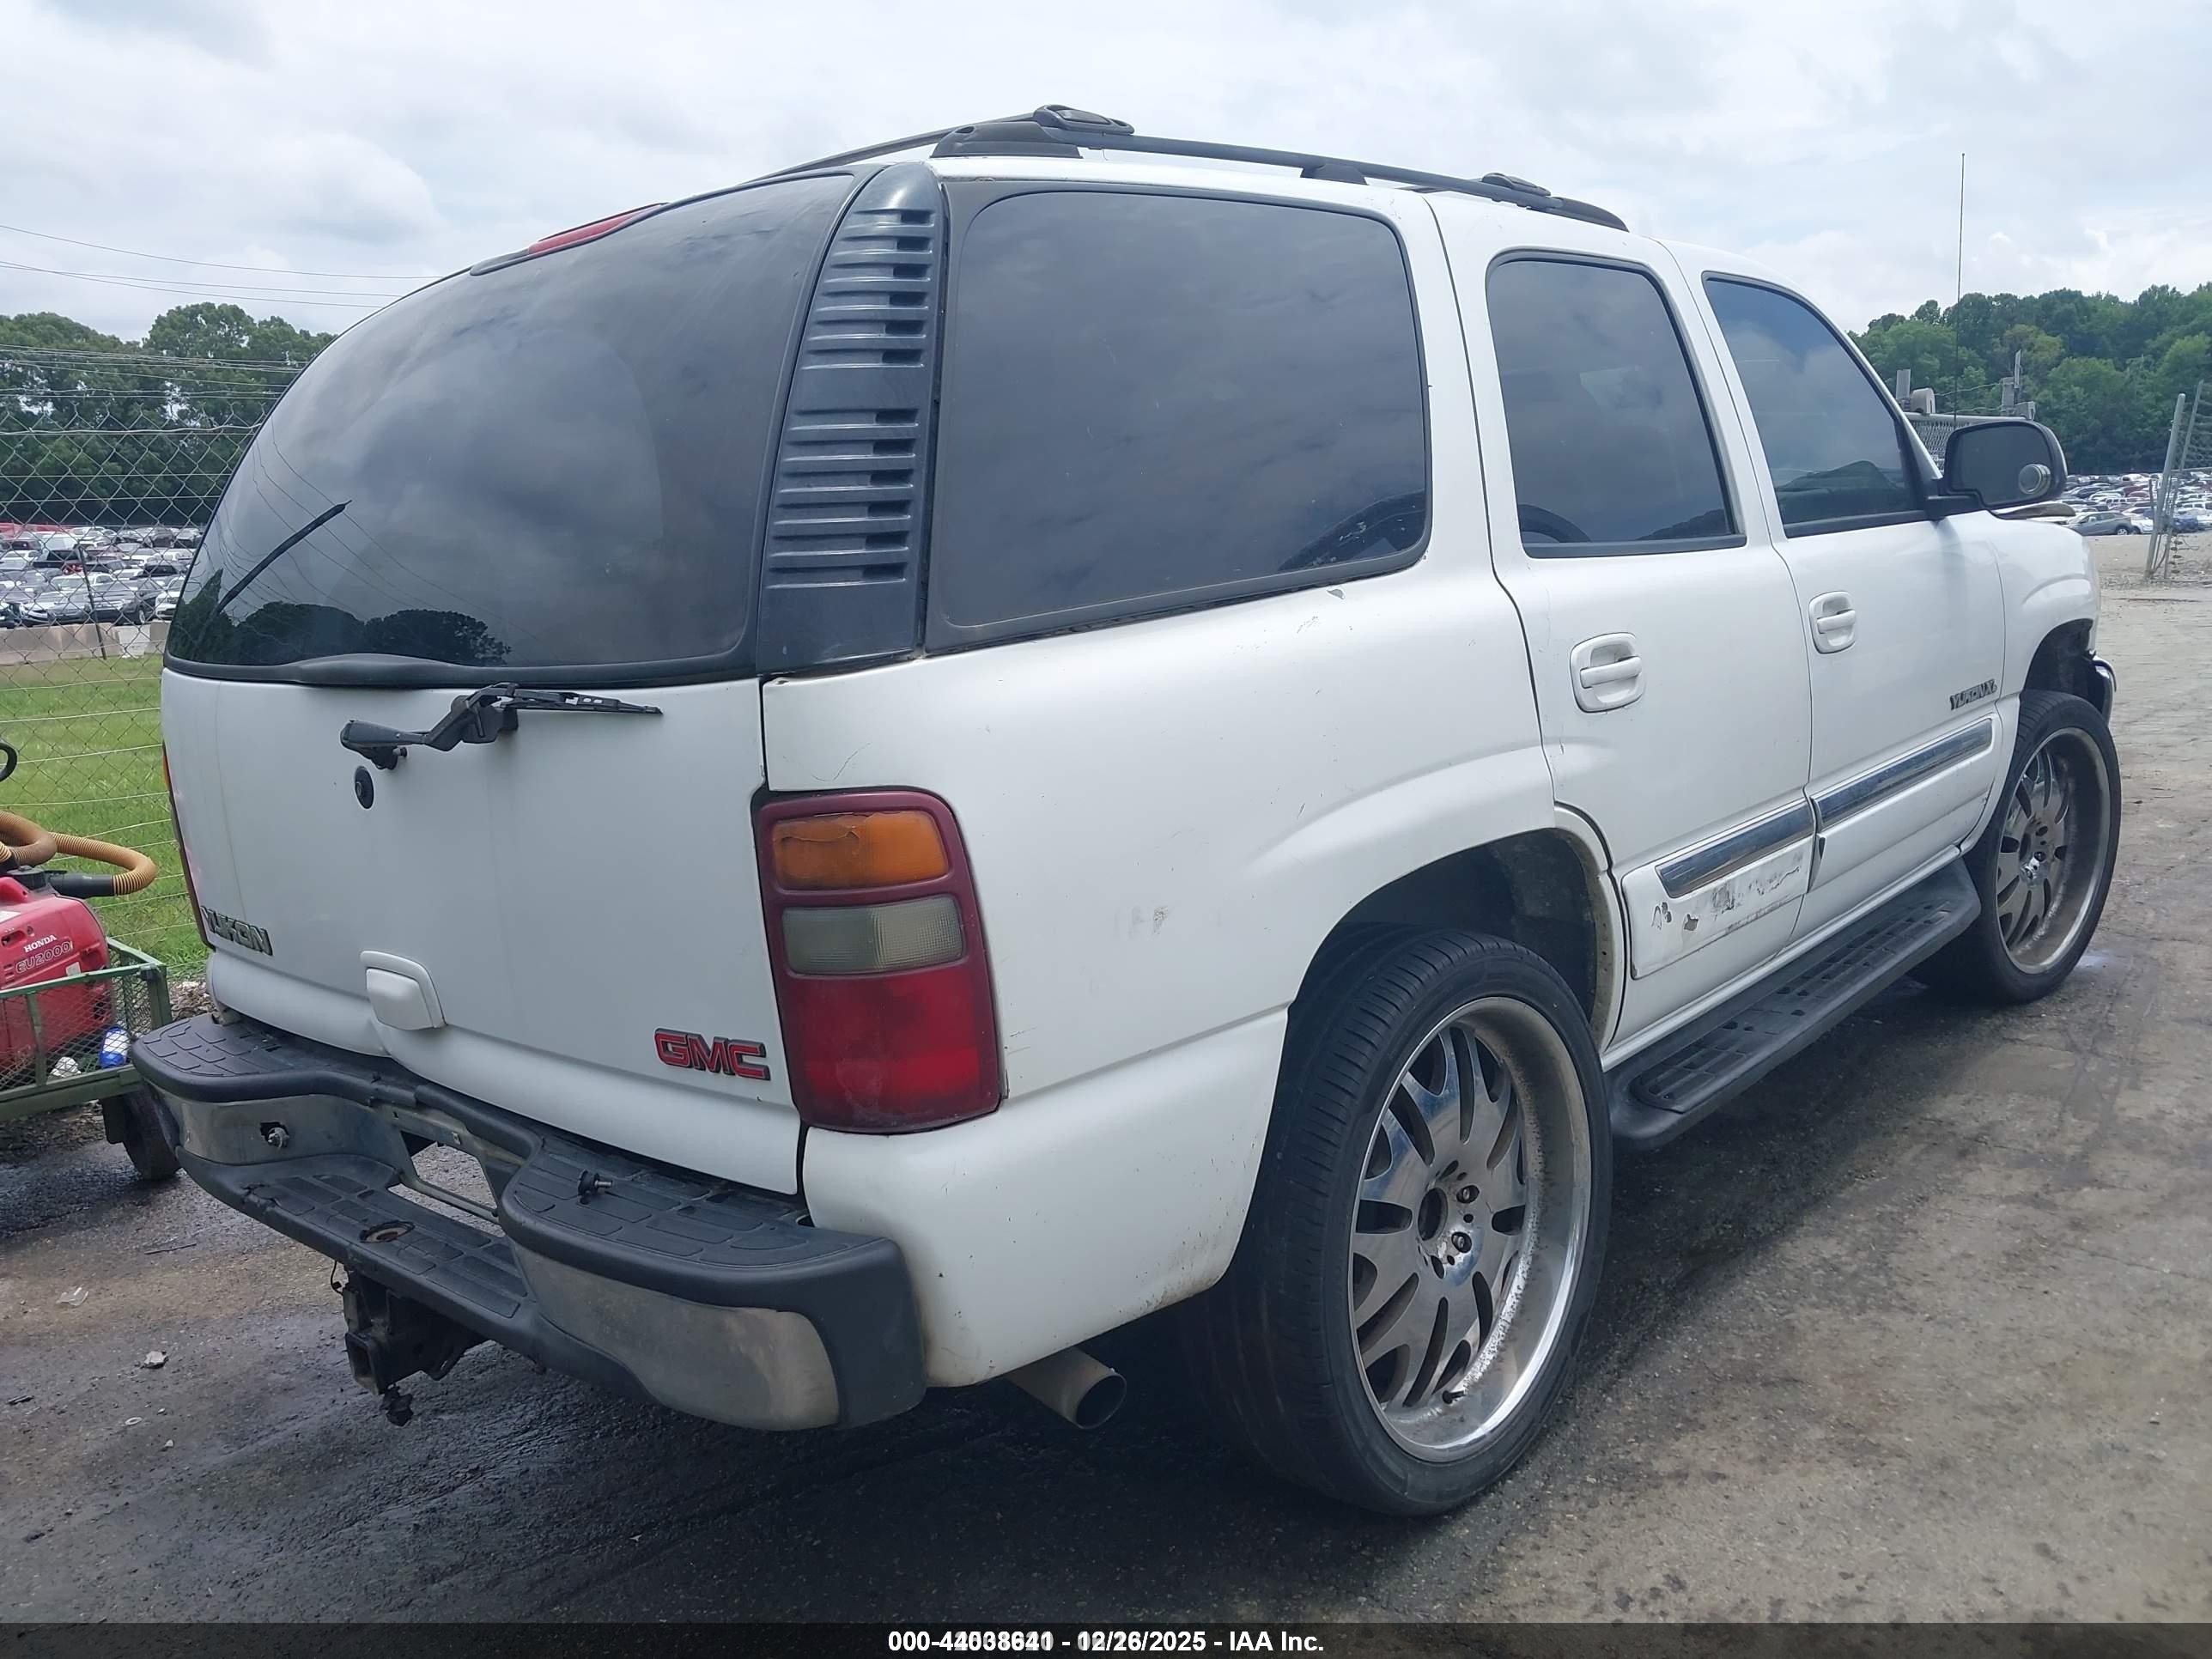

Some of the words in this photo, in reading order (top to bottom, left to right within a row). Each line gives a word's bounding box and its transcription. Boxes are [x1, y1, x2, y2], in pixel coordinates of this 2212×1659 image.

[23, 934, 58, 953] HONDA
[200, 905, 273, 957] YUKON
[654, 1027, 771, 1081] GMC
